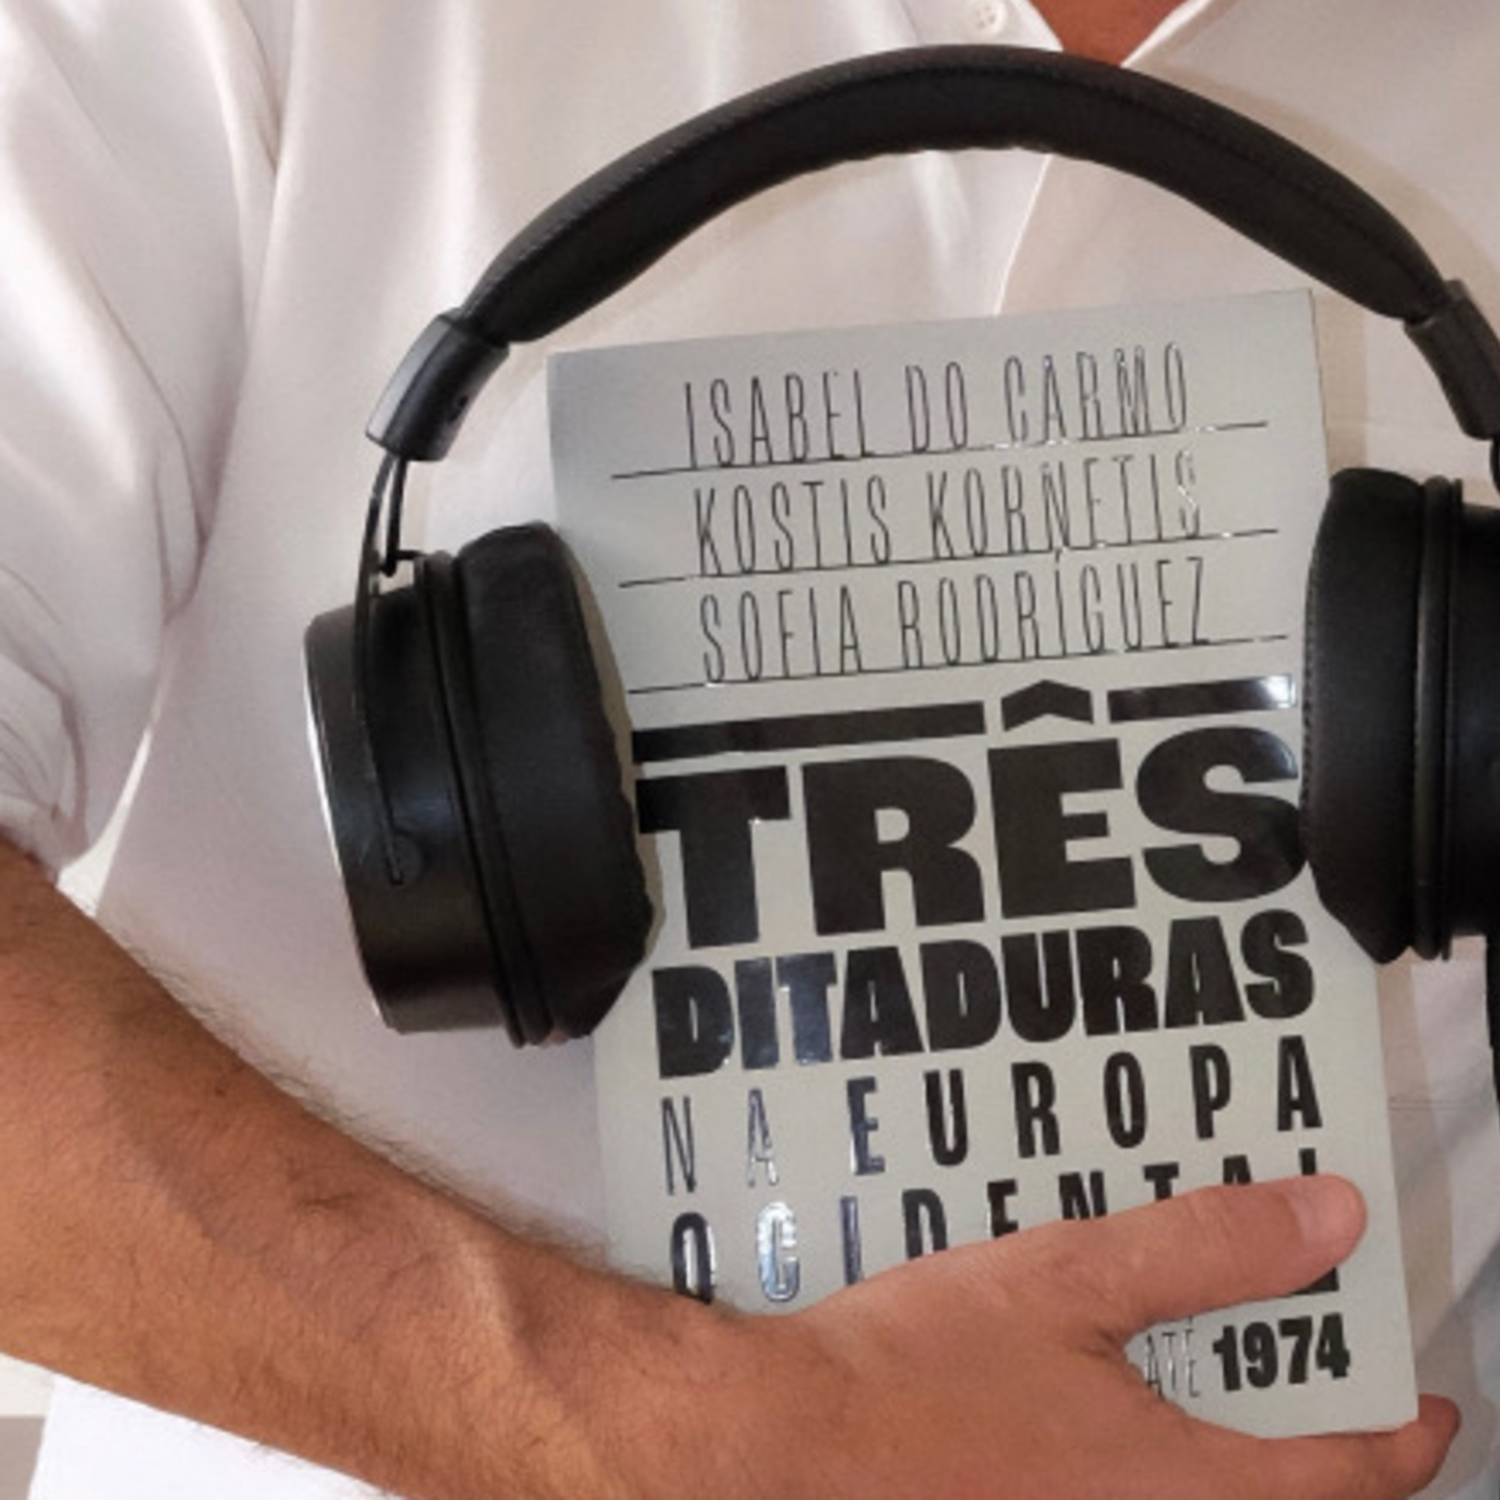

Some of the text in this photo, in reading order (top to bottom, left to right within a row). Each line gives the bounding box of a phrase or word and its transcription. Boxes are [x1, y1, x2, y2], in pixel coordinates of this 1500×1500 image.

[685, 342, 1188, 470] ISABEL DO CARMO
[694, 449, 1200, 577] KOSTIS KORNETIS
[700, 551, 1210, 683] SOFIA RODRÍGUEZ
[635, 679, 1309, 949] TRÊS
[652, 908, 1314, 1079] DITADURAS
[661, 1034, 1324, 1196] NA EUROPA
[670, 1148, 1317, 1305] OCIDE
[1212, 1312, 1351, 1392] 1974
